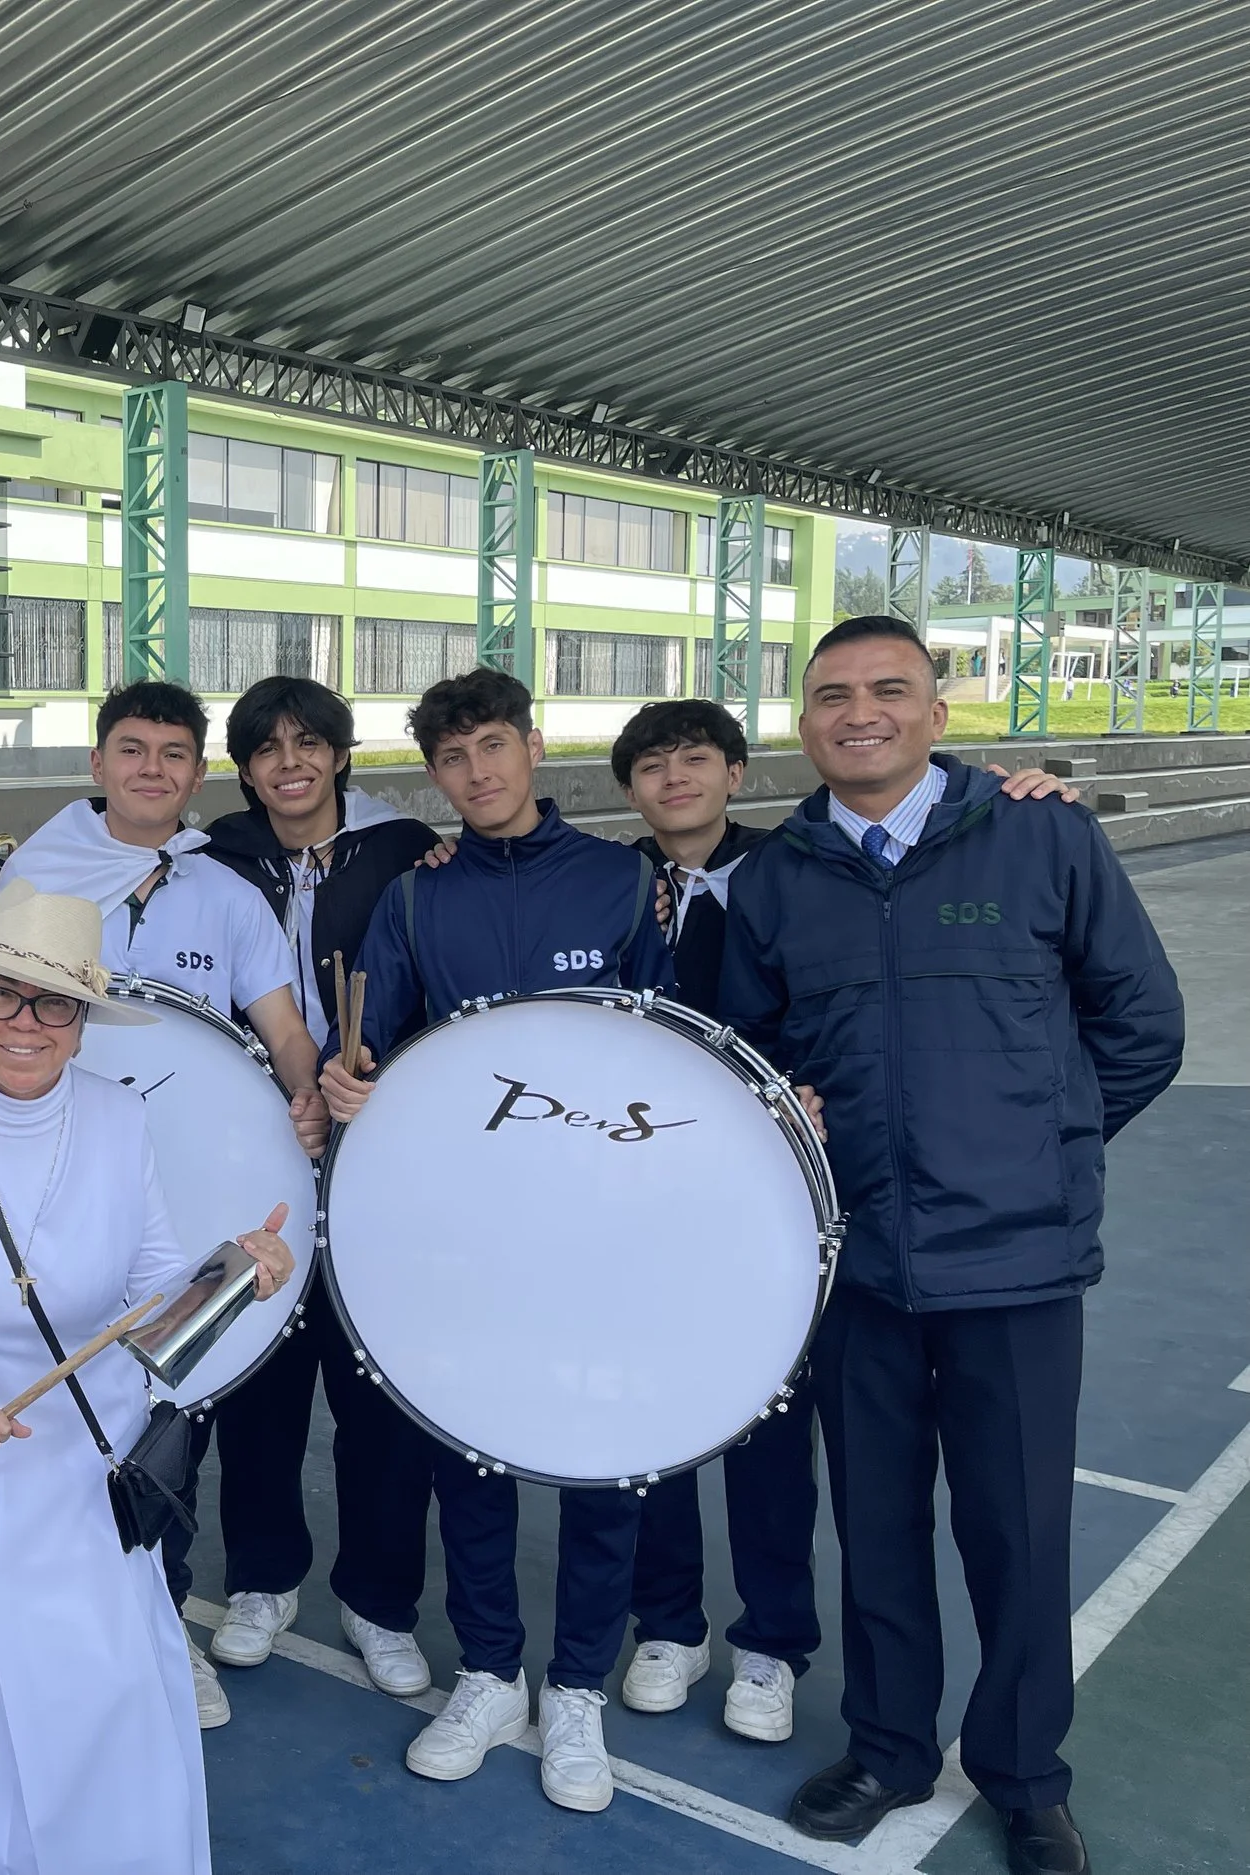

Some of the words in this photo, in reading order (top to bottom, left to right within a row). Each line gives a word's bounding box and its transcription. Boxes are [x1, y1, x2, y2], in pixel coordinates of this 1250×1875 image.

[937, 902, 1001, 925] SDS
[176, 951, 214, 971] SDS
[553, 949, 604, 972] SDS
